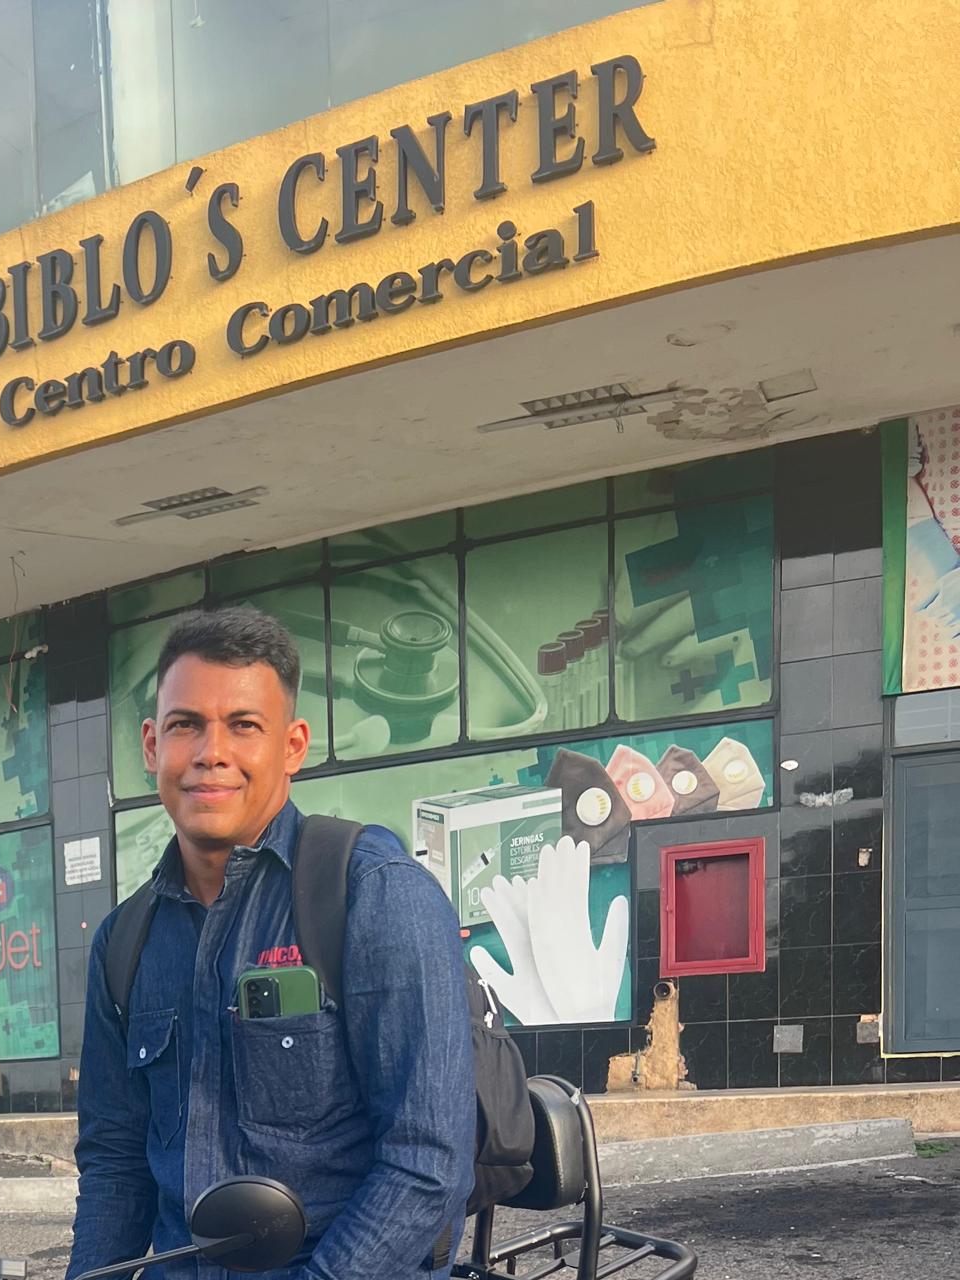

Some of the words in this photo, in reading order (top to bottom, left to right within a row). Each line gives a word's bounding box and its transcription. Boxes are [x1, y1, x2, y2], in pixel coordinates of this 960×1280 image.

[277, 54, 657, 256] CENTER
[226, 200, 601, 357] Comercial
[510, 832, 544, 847] JERINGAS
